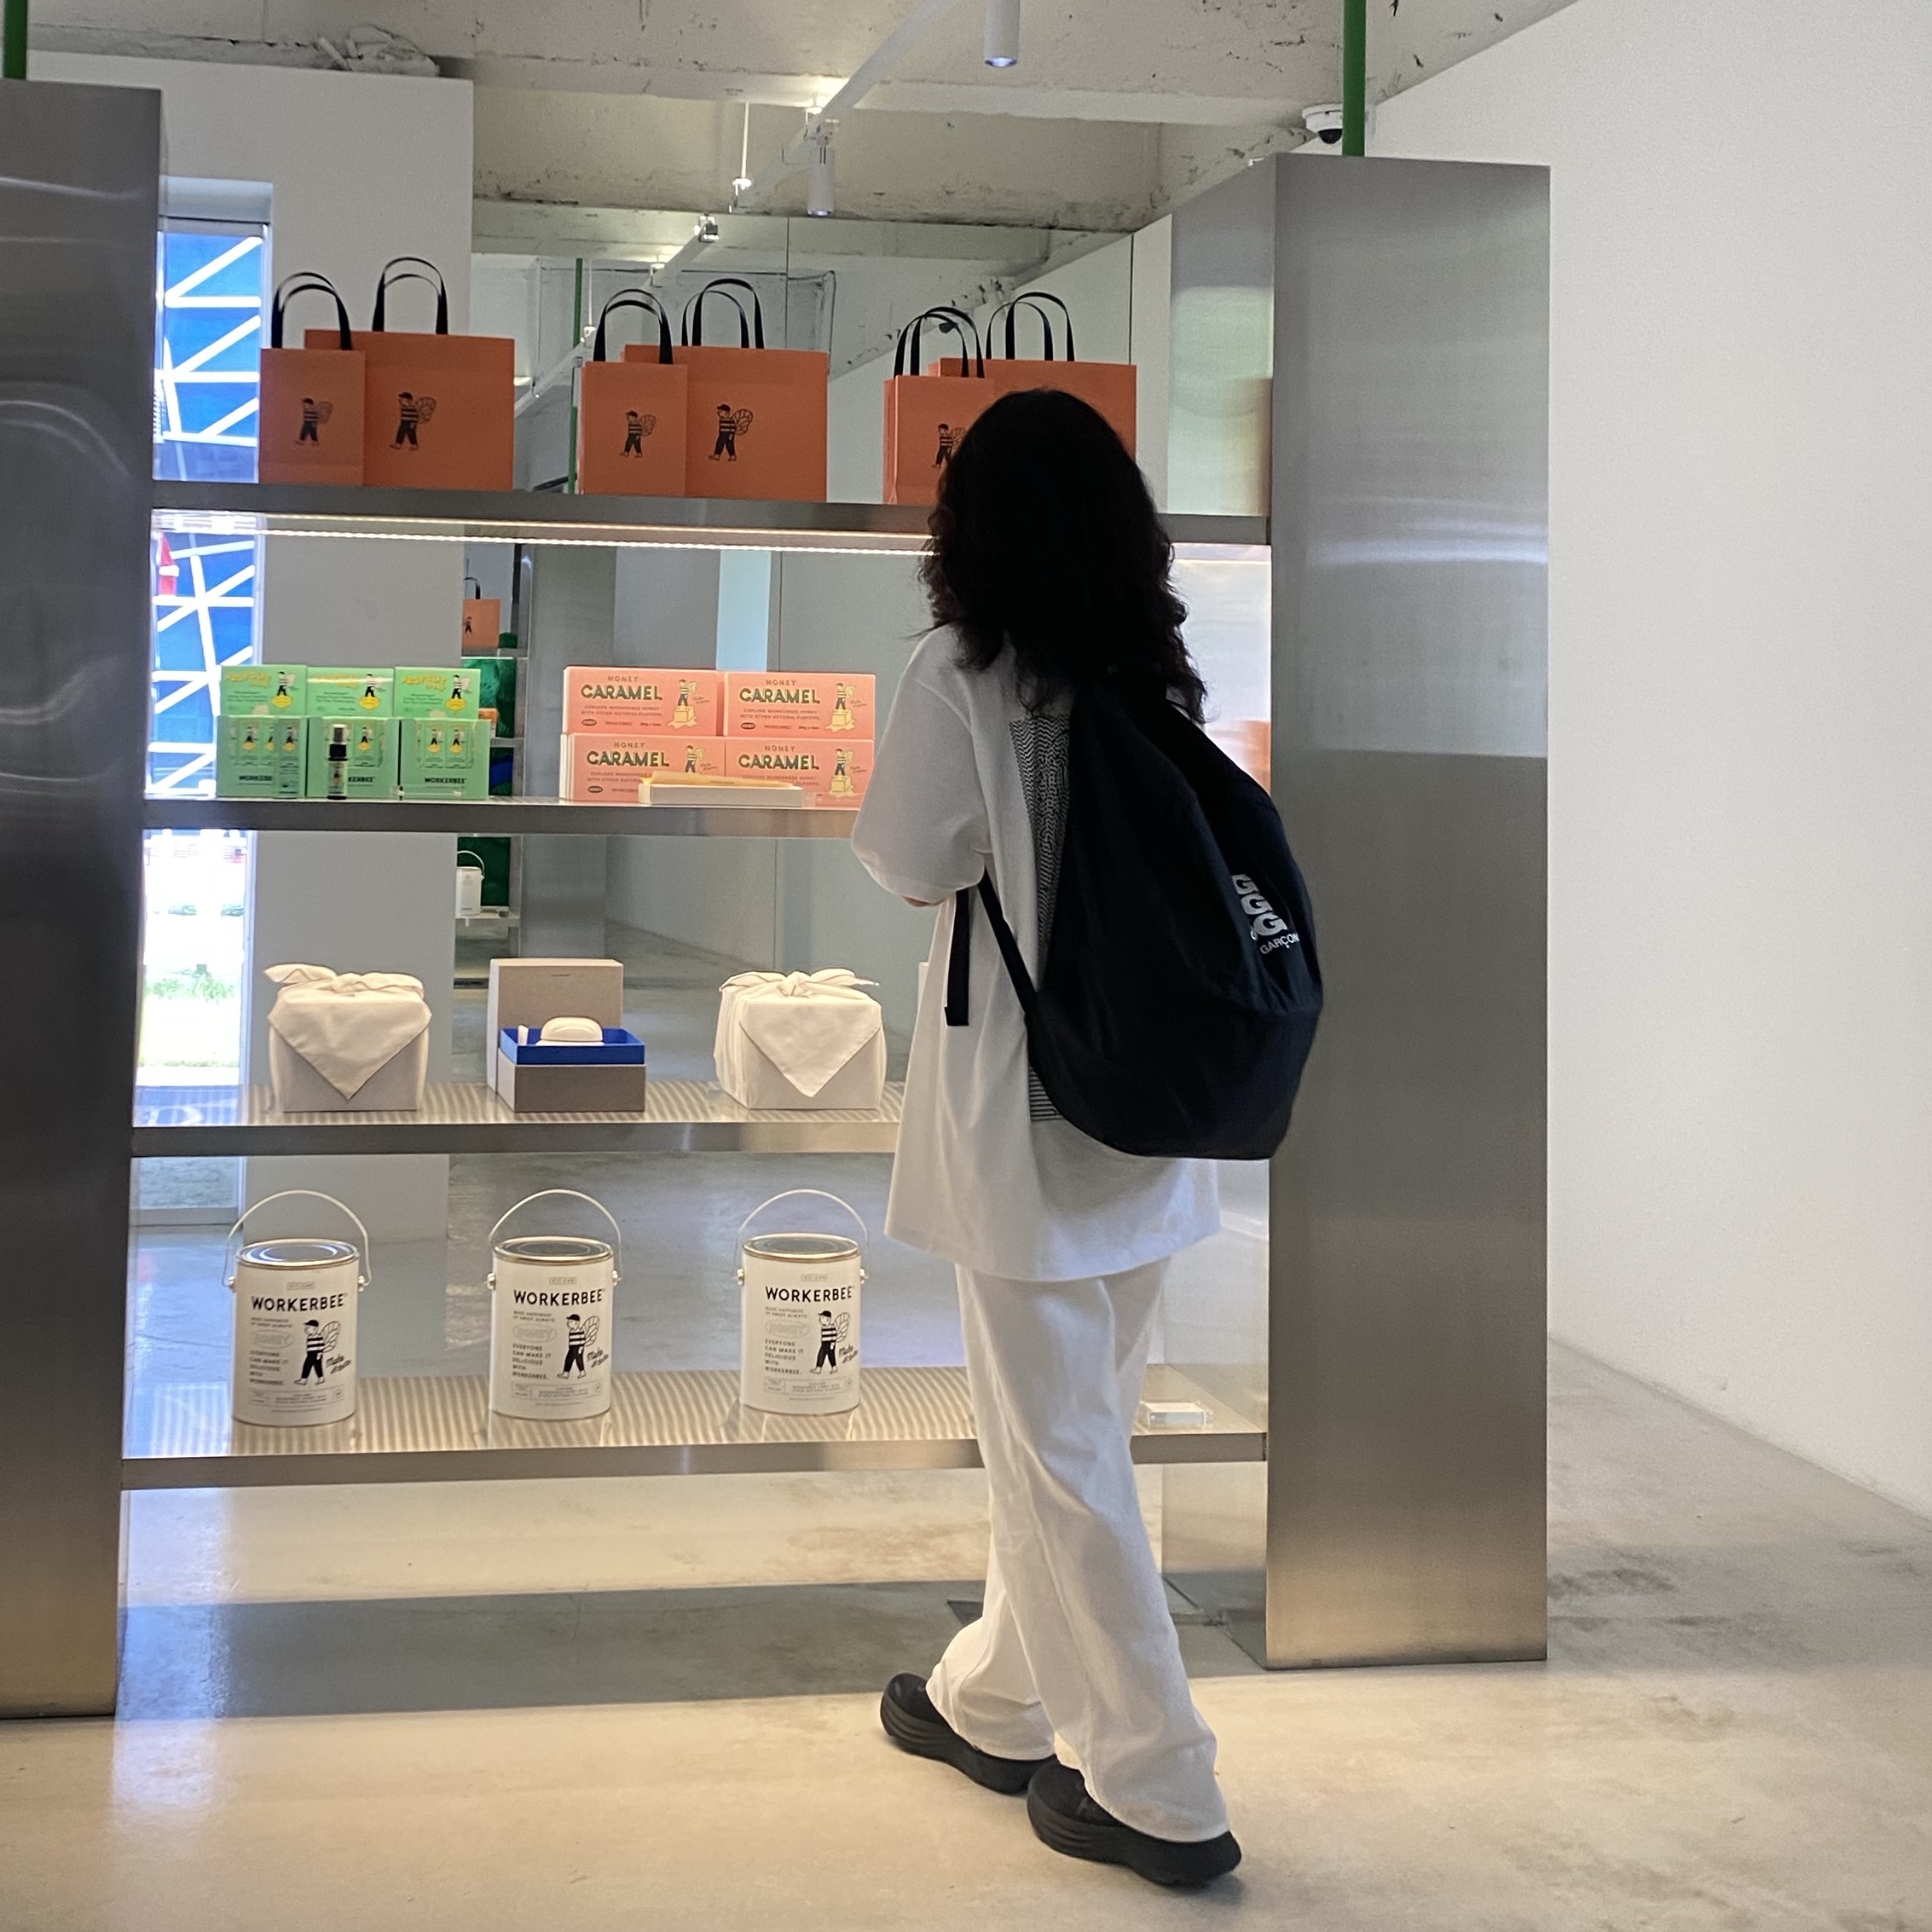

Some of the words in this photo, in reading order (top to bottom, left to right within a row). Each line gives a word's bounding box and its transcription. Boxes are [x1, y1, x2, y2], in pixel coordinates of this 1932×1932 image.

[581, 684, 662, 701] CARAMEL
[739, 687, 820, 704] CARAMEL
[587, 750, 669, 767] CARAMEL
[738, 754, 819, 770] CARAMEL
[251, 1293, 344, 1312] WORKERBEE
[513, 1289, 603, 1306] WORKERBEE
[765, 1285, 853, 1303] WORKERBEE
